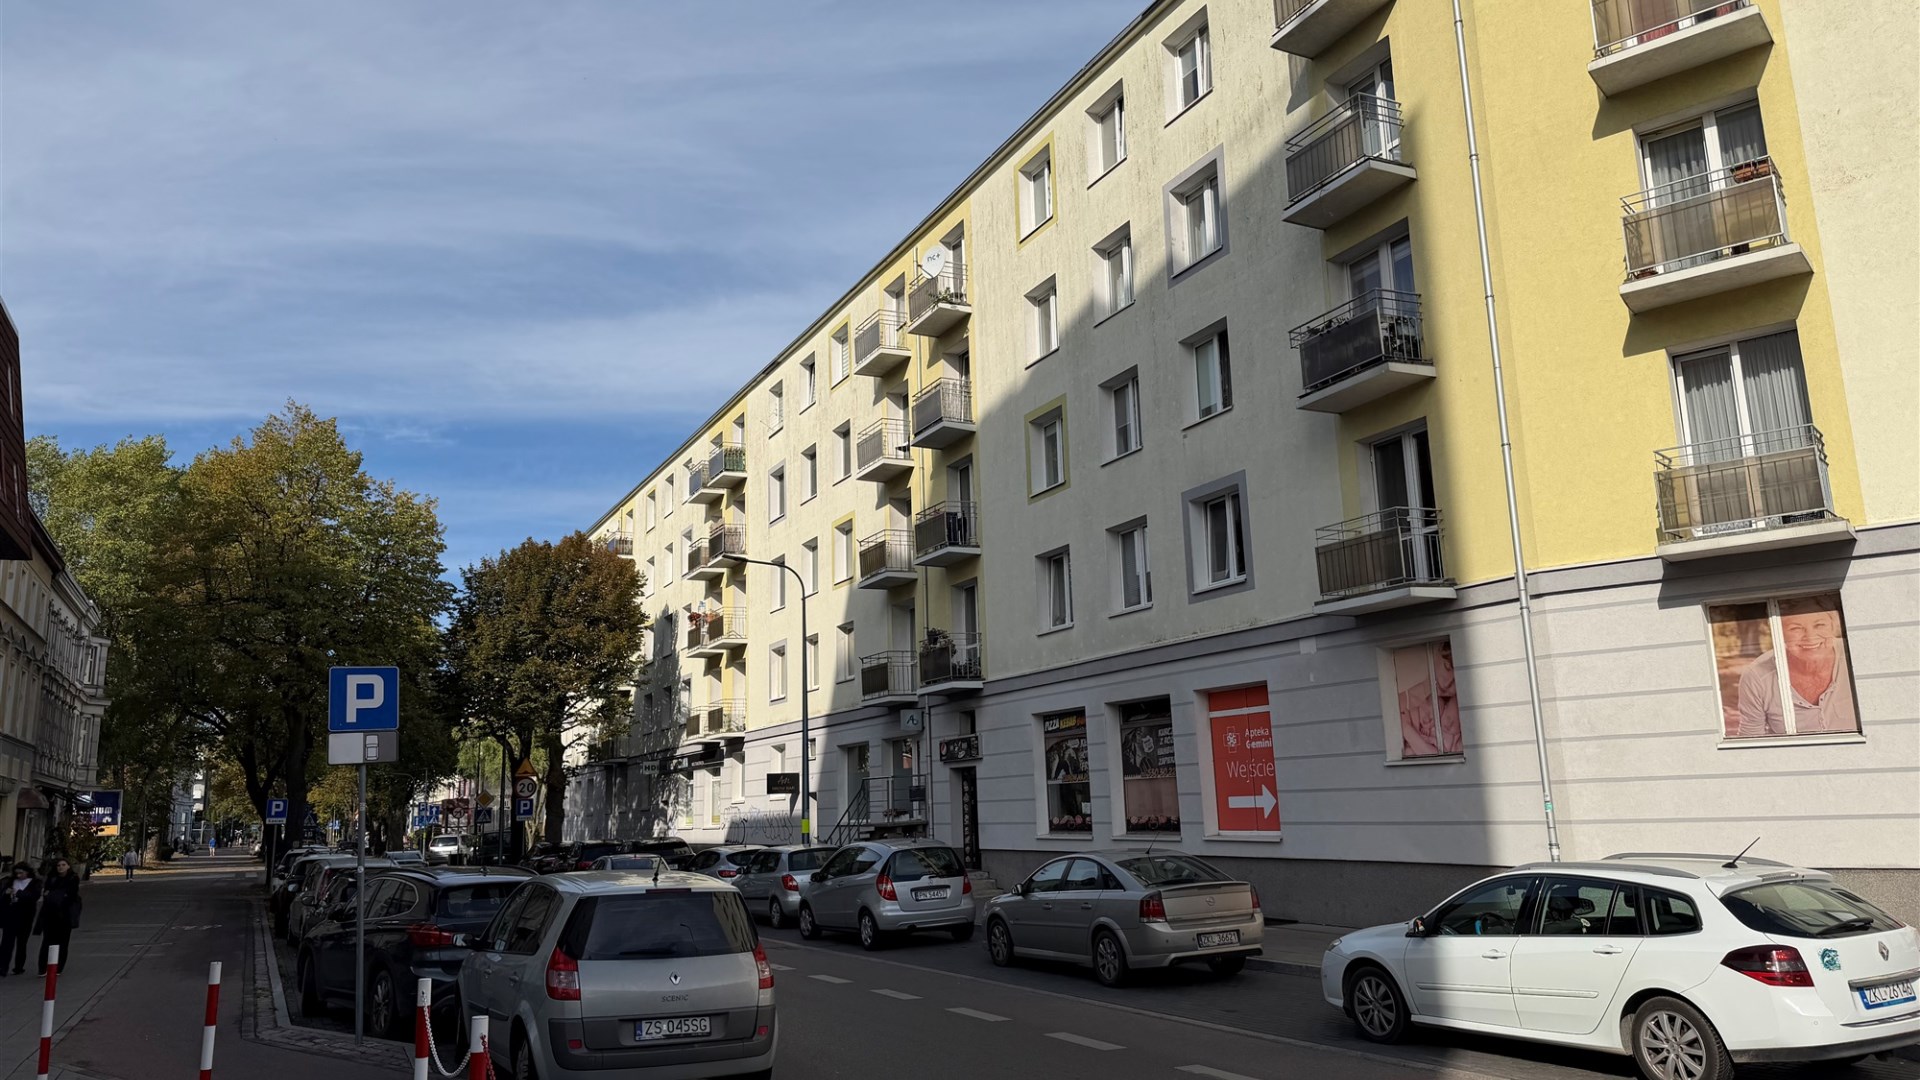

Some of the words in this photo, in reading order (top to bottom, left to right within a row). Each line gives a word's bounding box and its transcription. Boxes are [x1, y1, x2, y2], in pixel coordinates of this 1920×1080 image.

[346, 673, 385, 723] P
[1044, 718, 1060, 732] PIZZA
[1244, 727, 1269, 739] Apteka
[1245, 737, 1272, 749] Gemini
[1226, 758, 1275, 783] Wejście
[519, 783, 534, 793] 20
[271, 801, 284, 816] P
[520, 800, 530, 814] P
[1202, 935, 1215, 944] ZKL
[1217, 932, 1236, 942] 36621
[661, 994, 689, 1002] SCENIC
[1868, 986, 1887, 1003] ZKL
[644, 1021, 662, 1035] ZS
[667, 1018, 707, 1033] 045SG
